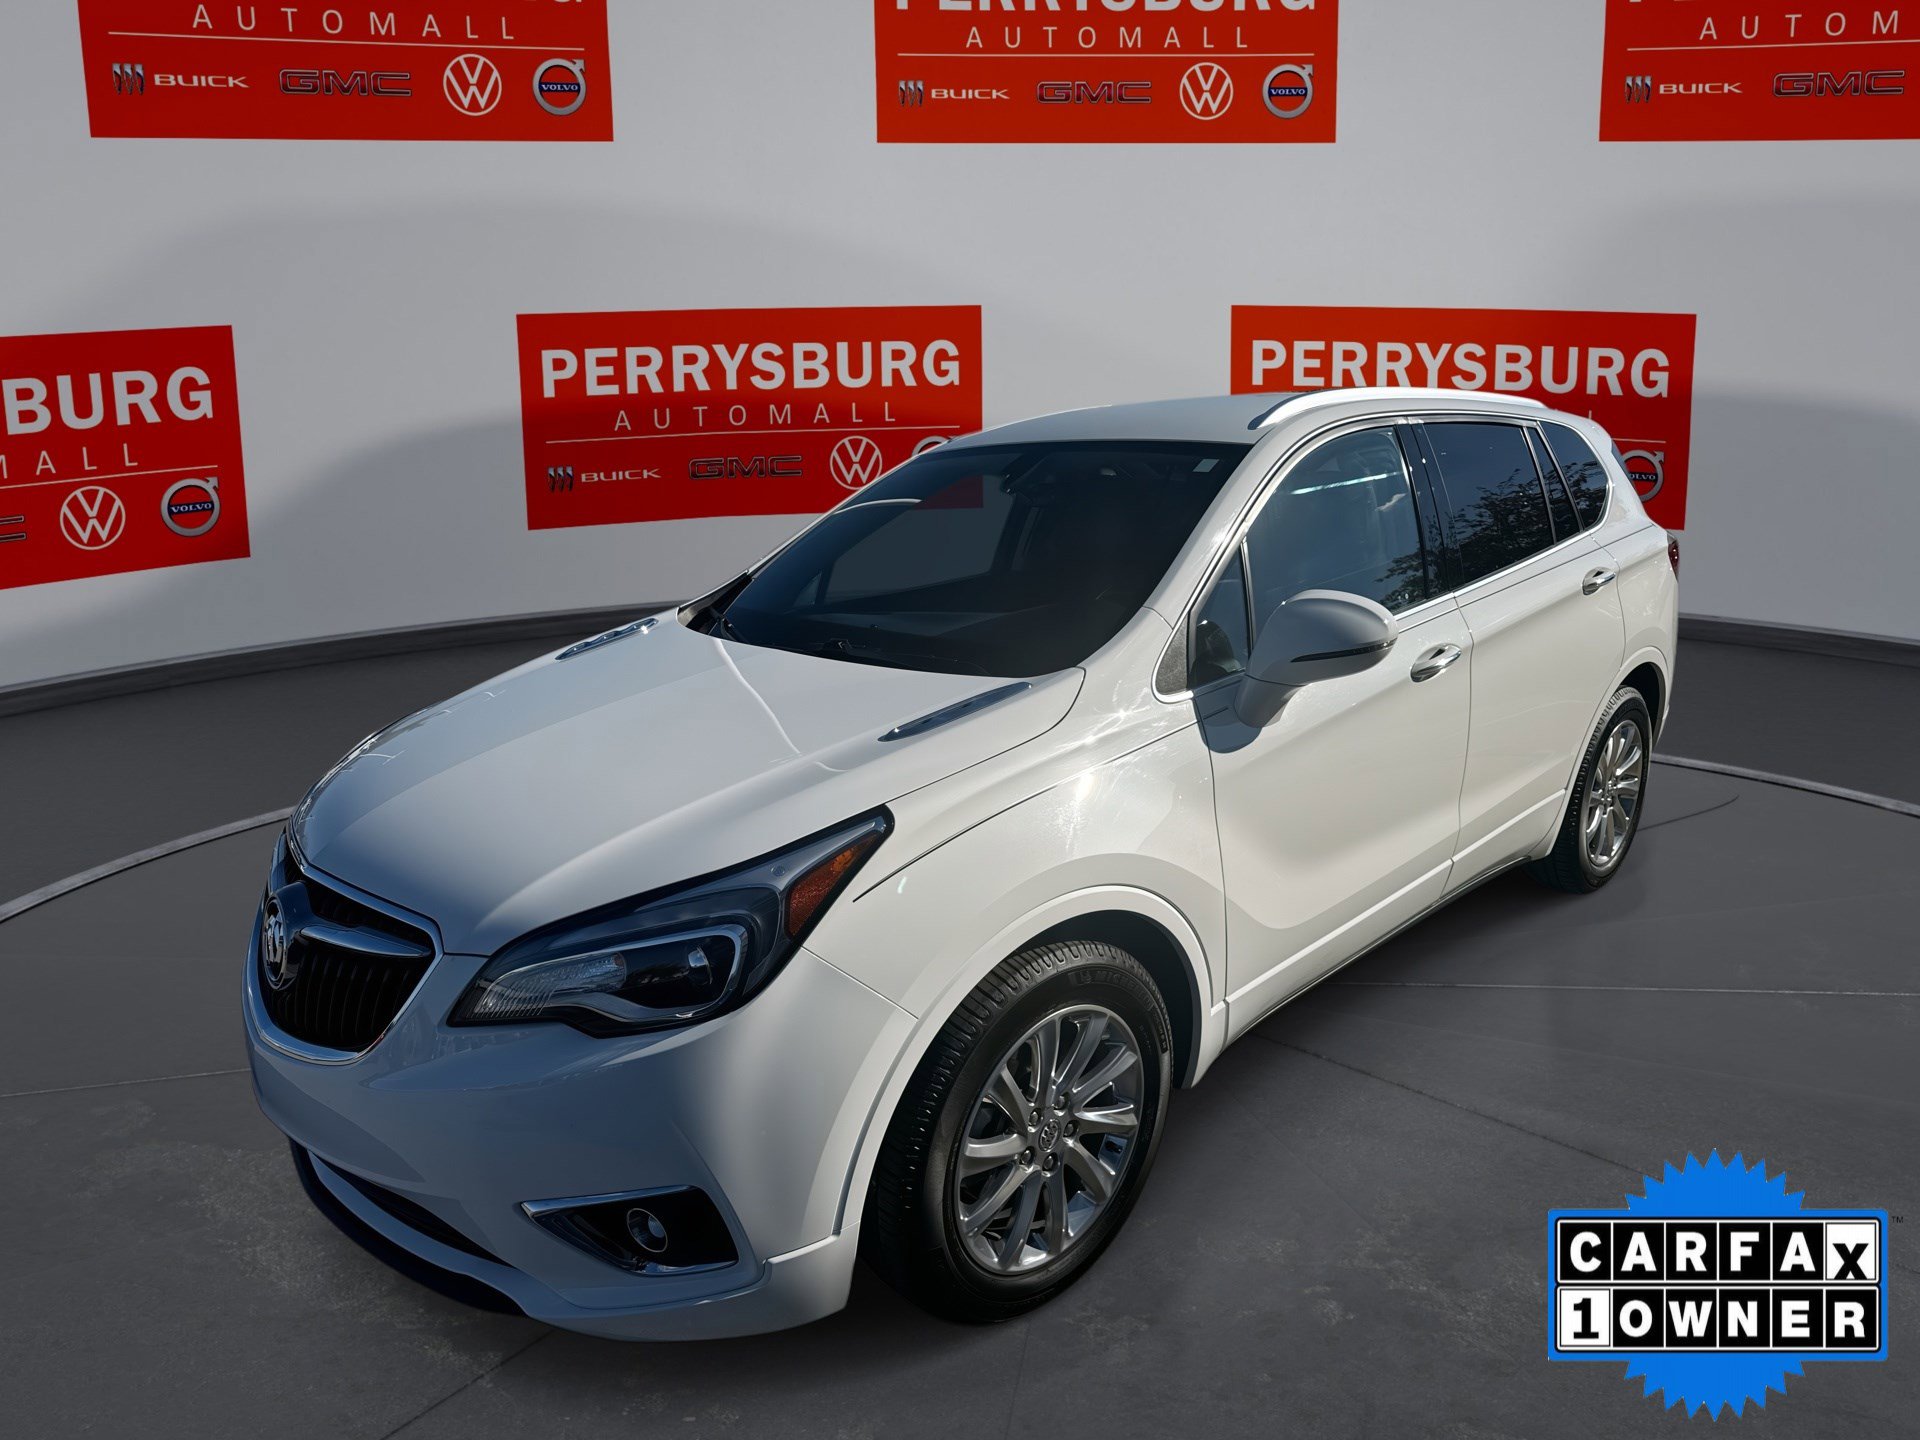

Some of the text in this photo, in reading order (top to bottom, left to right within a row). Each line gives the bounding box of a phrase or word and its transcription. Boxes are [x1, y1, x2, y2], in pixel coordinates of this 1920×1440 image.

[192, 5, 515, 40] AUTOMALL
[1699, 10, 1899, 41] AUTOM
[965, 26, 1249, 49] AUTOMALL
[153, 68, 412, 97] BUICK GMC
[540, 82, 580, 92] VOLVO
[930, 80, 1152, 105] BUICK GMC
[1270, 87, 1306, 97] VOLVO
[1659, 70, 1905, 97] BUICK GMC
[541, 339, 960, 398] PERRYSBURG
[1251, 339, 1669, 398] PERRYSBURG
[1, 366, 214, 435] BURG
[614, 401, 896, 431] AUTOMALL
[581, 455, 803, 483] BUICK GMC
[170, 502, 212, 513] VOLVO
